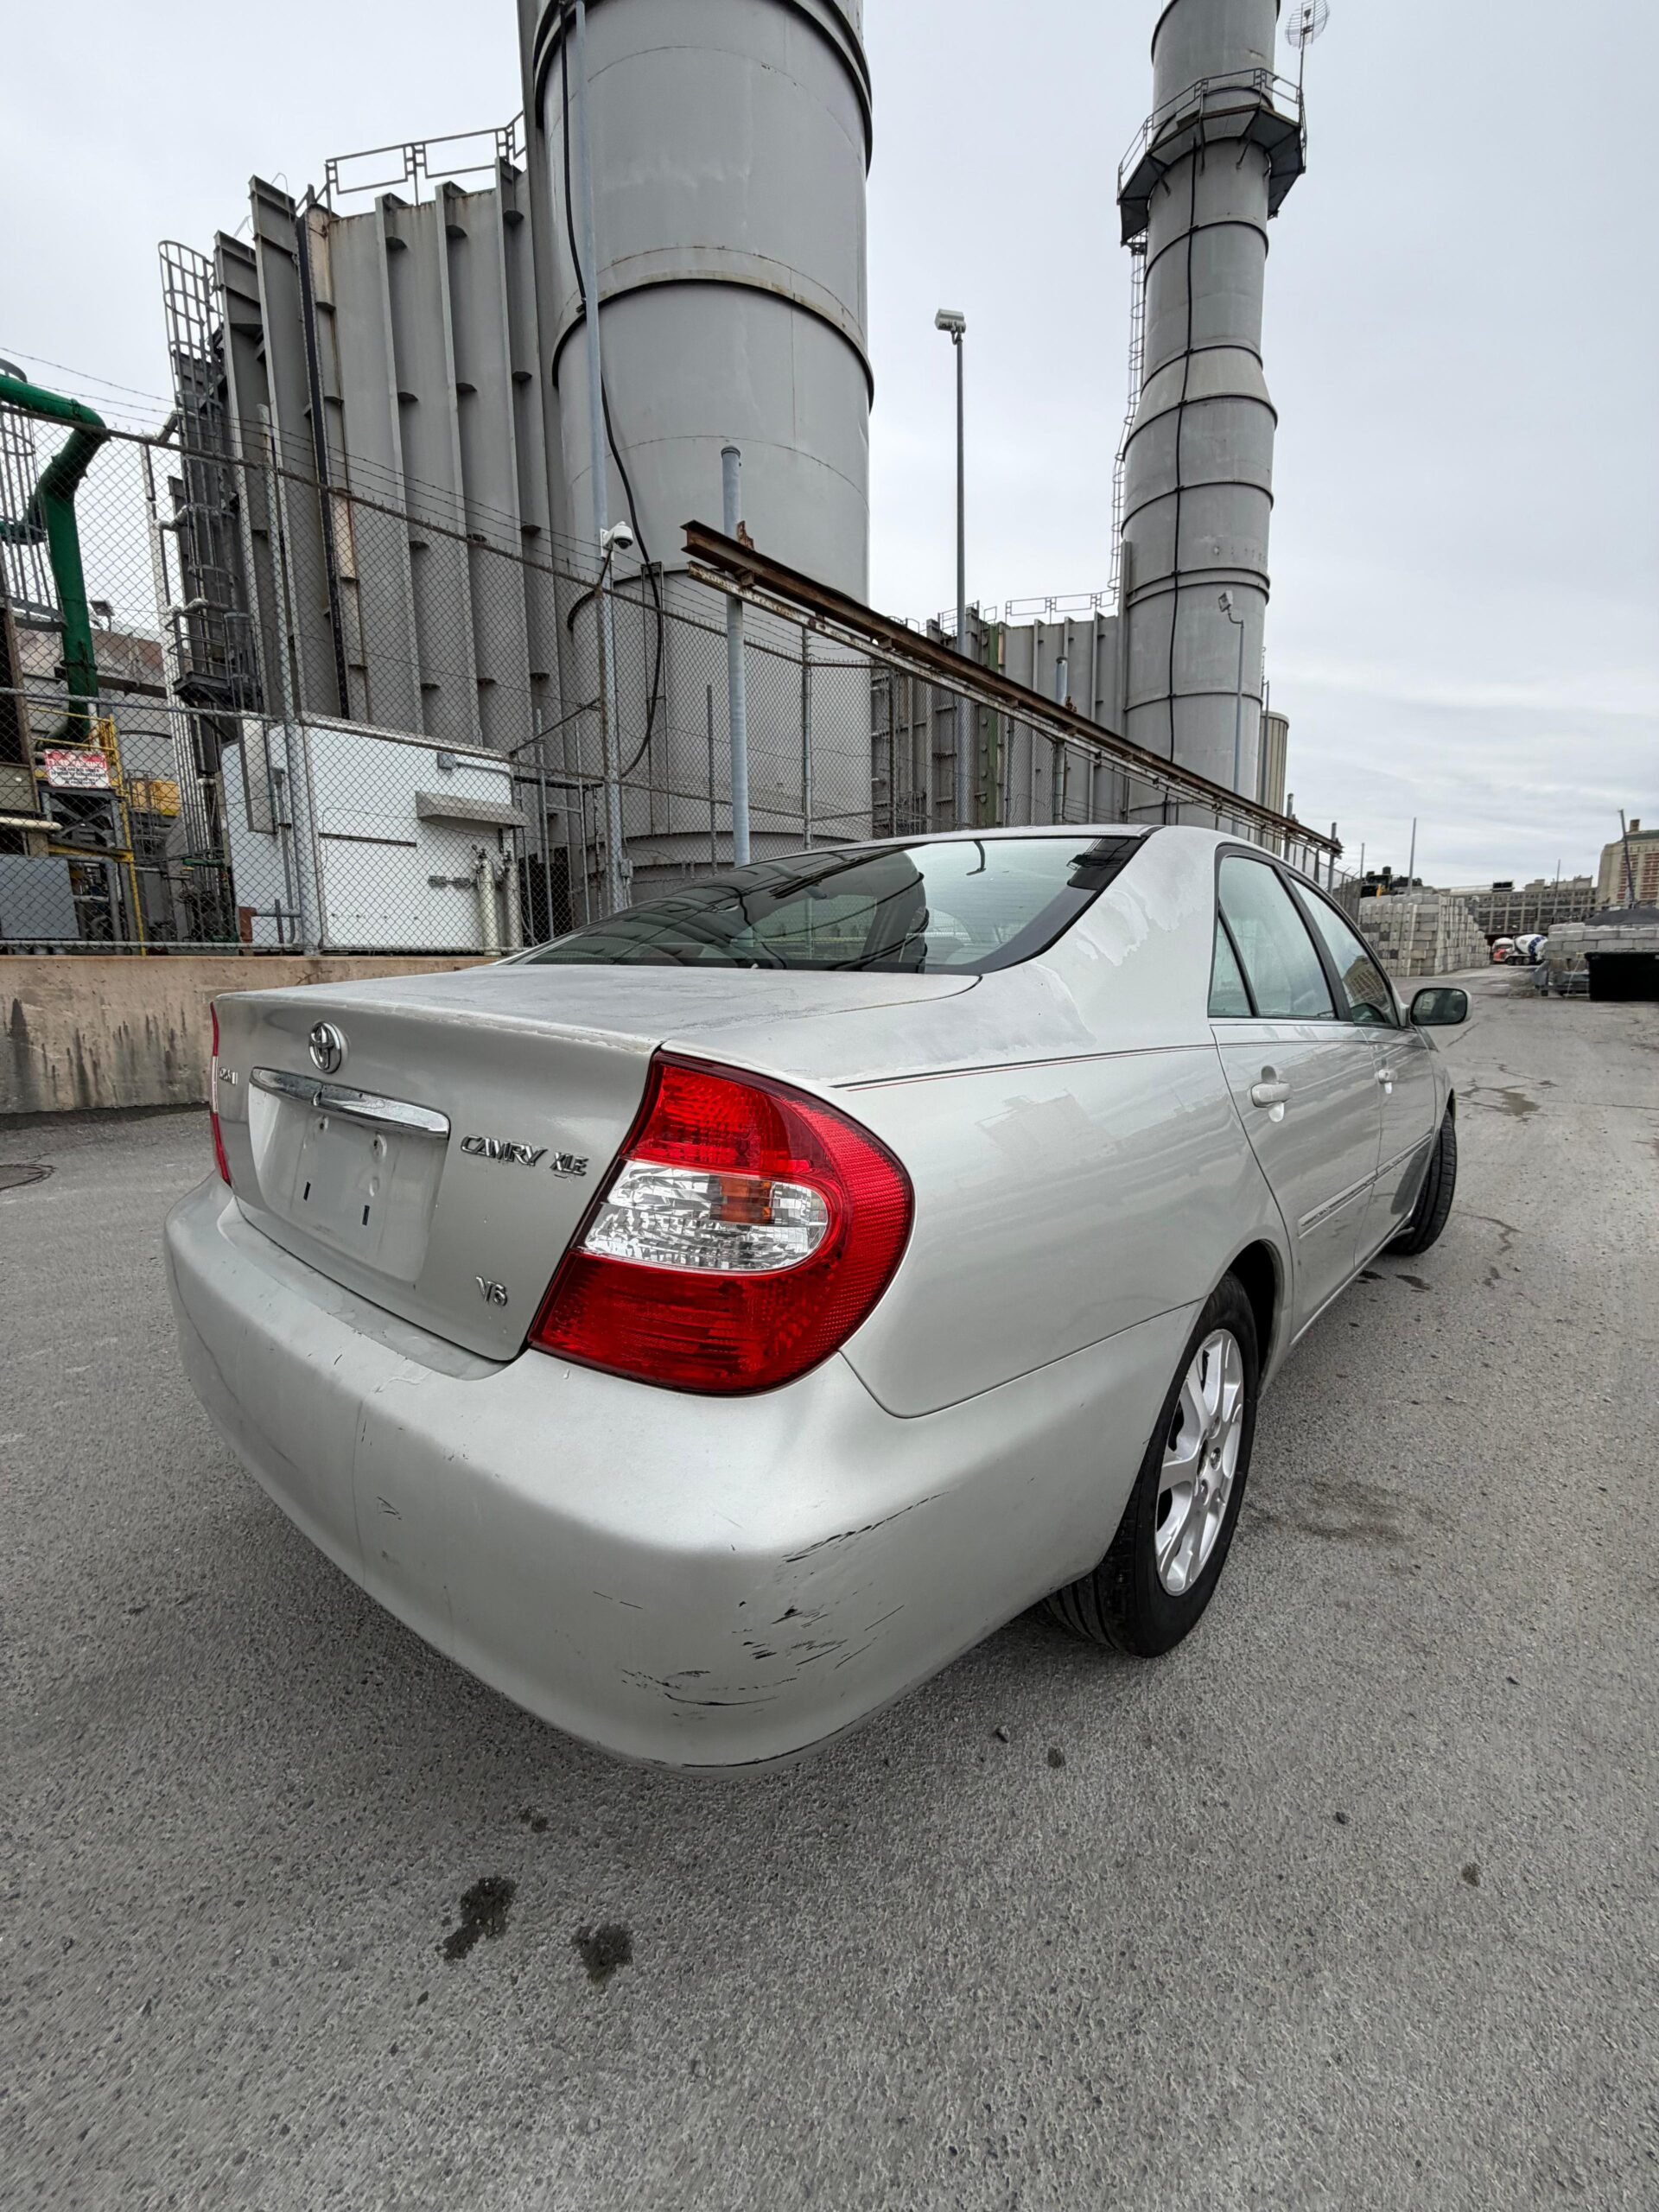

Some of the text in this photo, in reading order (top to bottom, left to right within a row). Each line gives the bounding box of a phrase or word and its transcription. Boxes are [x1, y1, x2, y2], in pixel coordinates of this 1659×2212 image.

[461, 1134, 589, 1176] CAMRY XLE
[475, 1275, 508, 1306] V6
